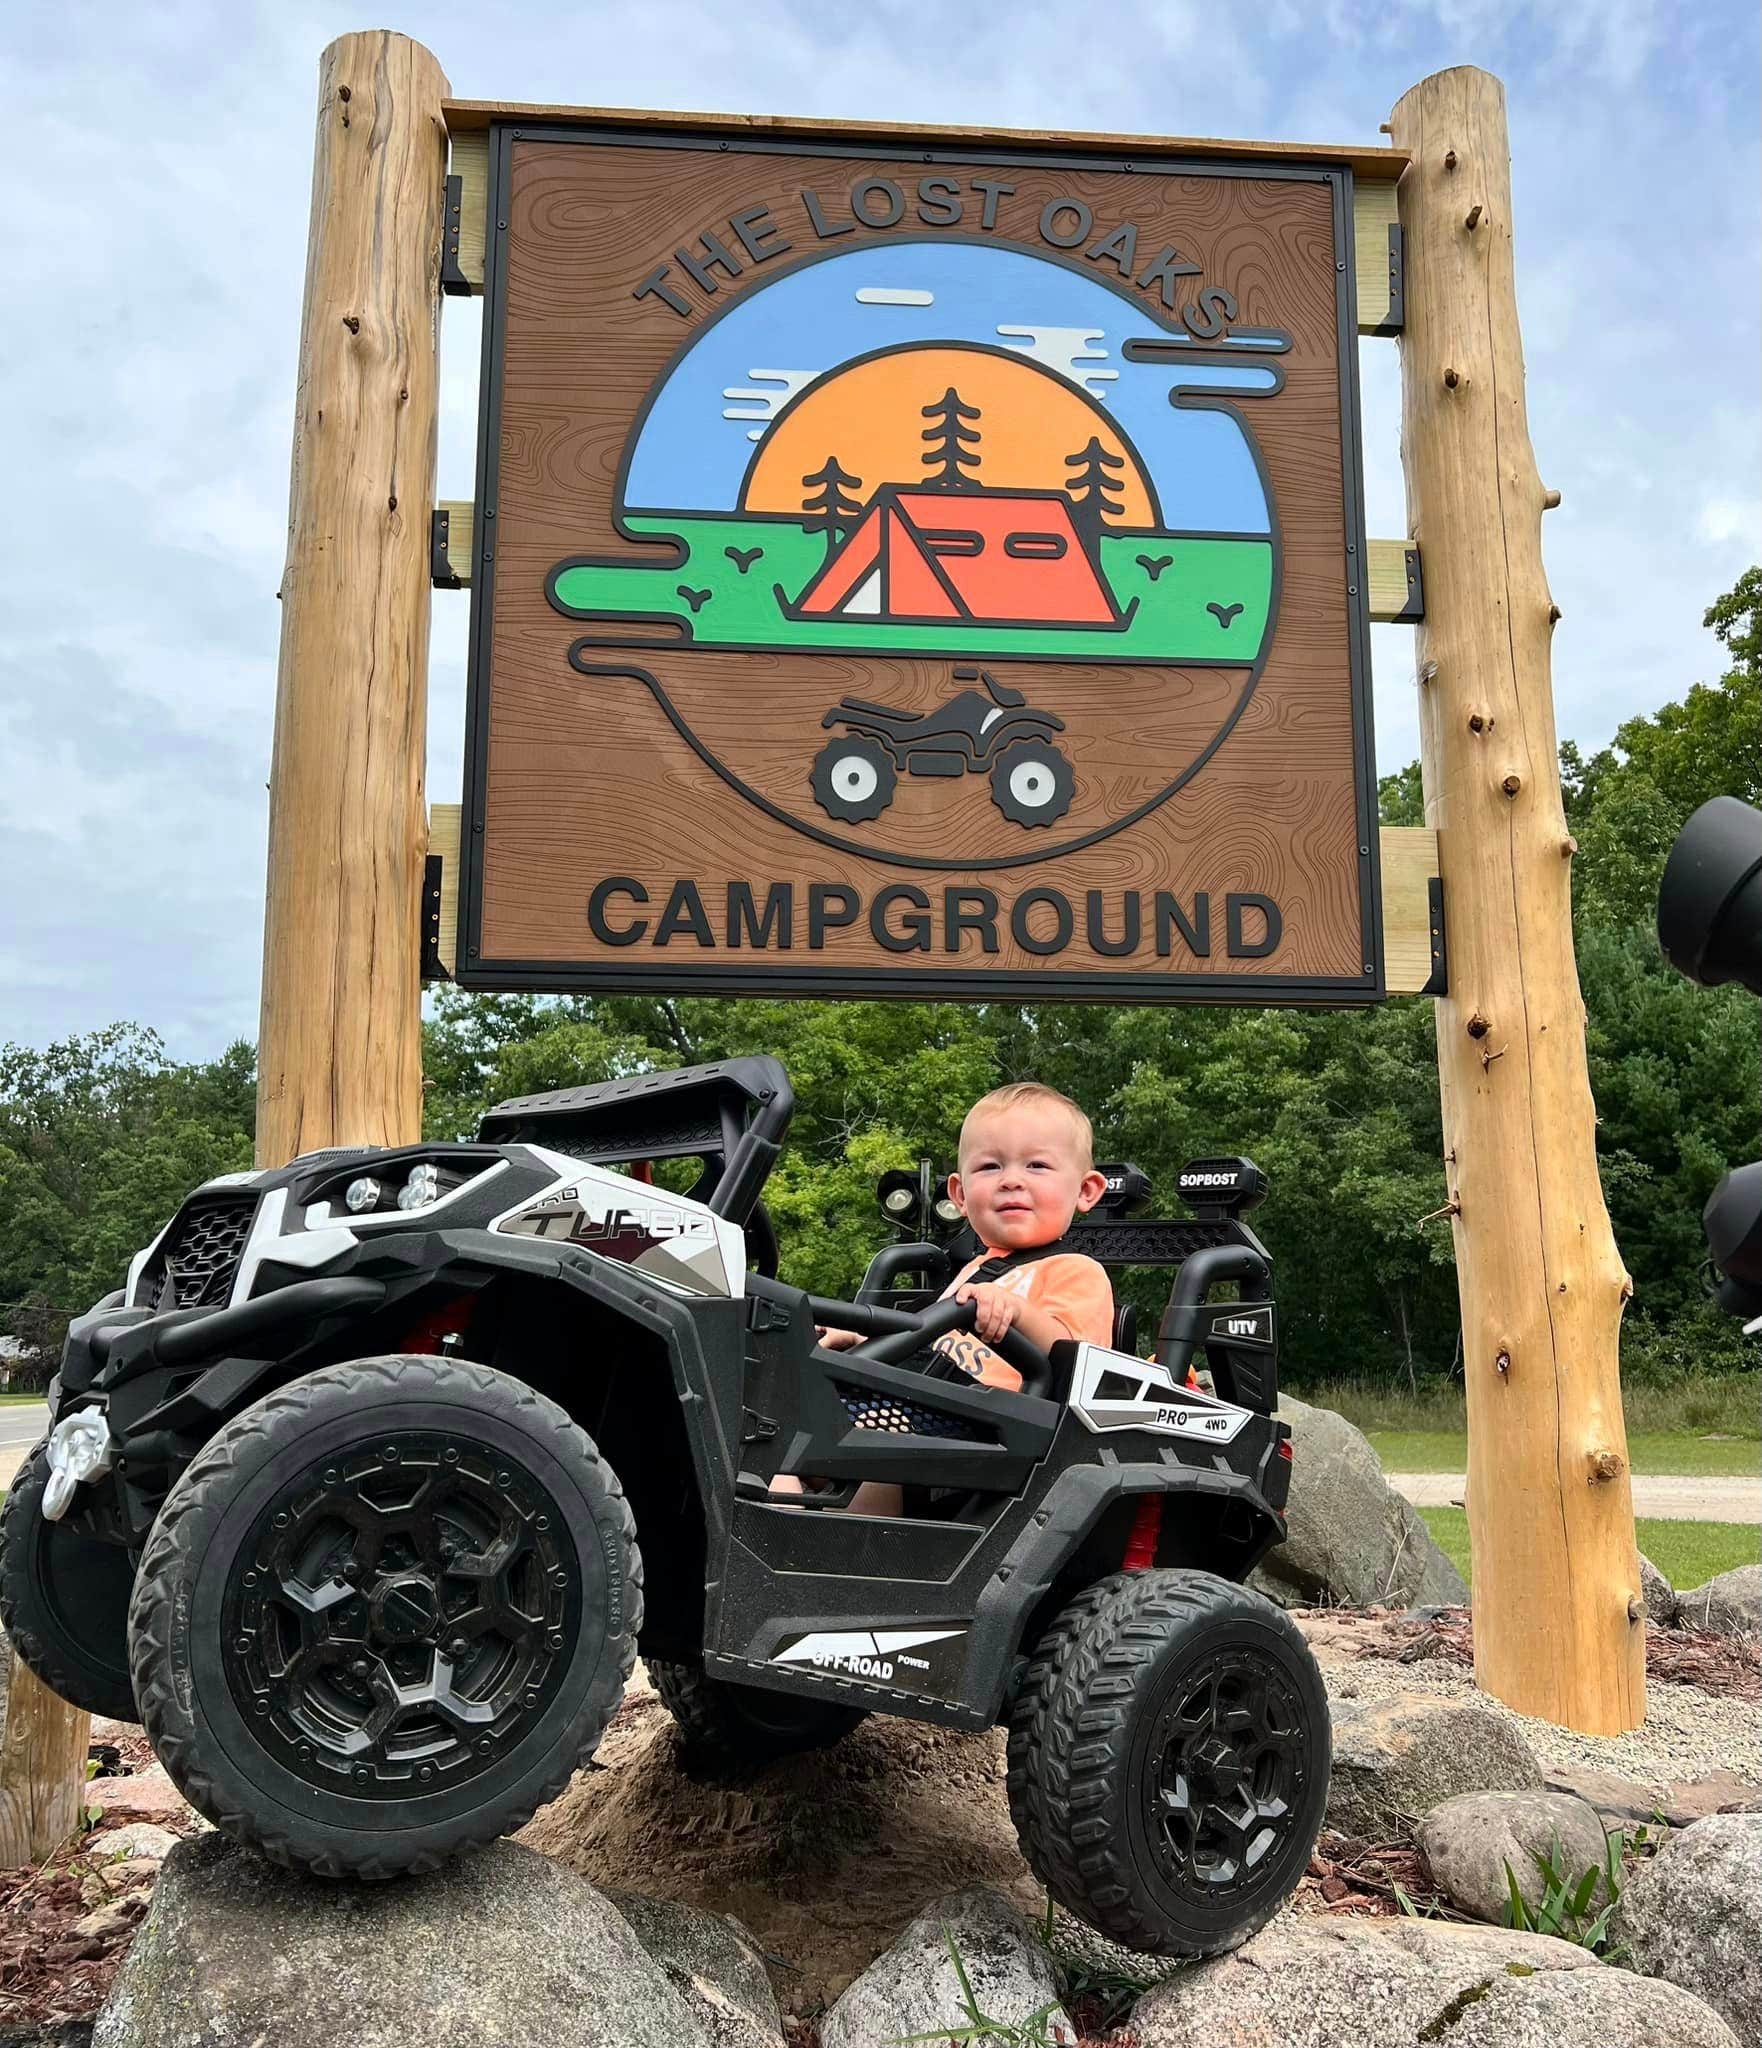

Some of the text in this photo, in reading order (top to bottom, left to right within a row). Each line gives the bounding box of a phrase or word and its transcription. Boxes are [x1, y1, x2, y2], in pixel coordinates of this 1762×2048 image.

[634, 176, 1239, 340] THE LOST OAKS
[587, 876, 1283, 958] CAMPGROUND
[1179, 1173, 1238, 1187] SOPBOST
[520, 1208, 715, 1240] TURBO
[1228, 1320, 1258, 1335] UTV
[1156, 1408, 1188, 1426] PRO
[1205, 1418, 1228, 1431] 4WD
[812, 1651, 931, 1680] OFF-ROAD POWER
